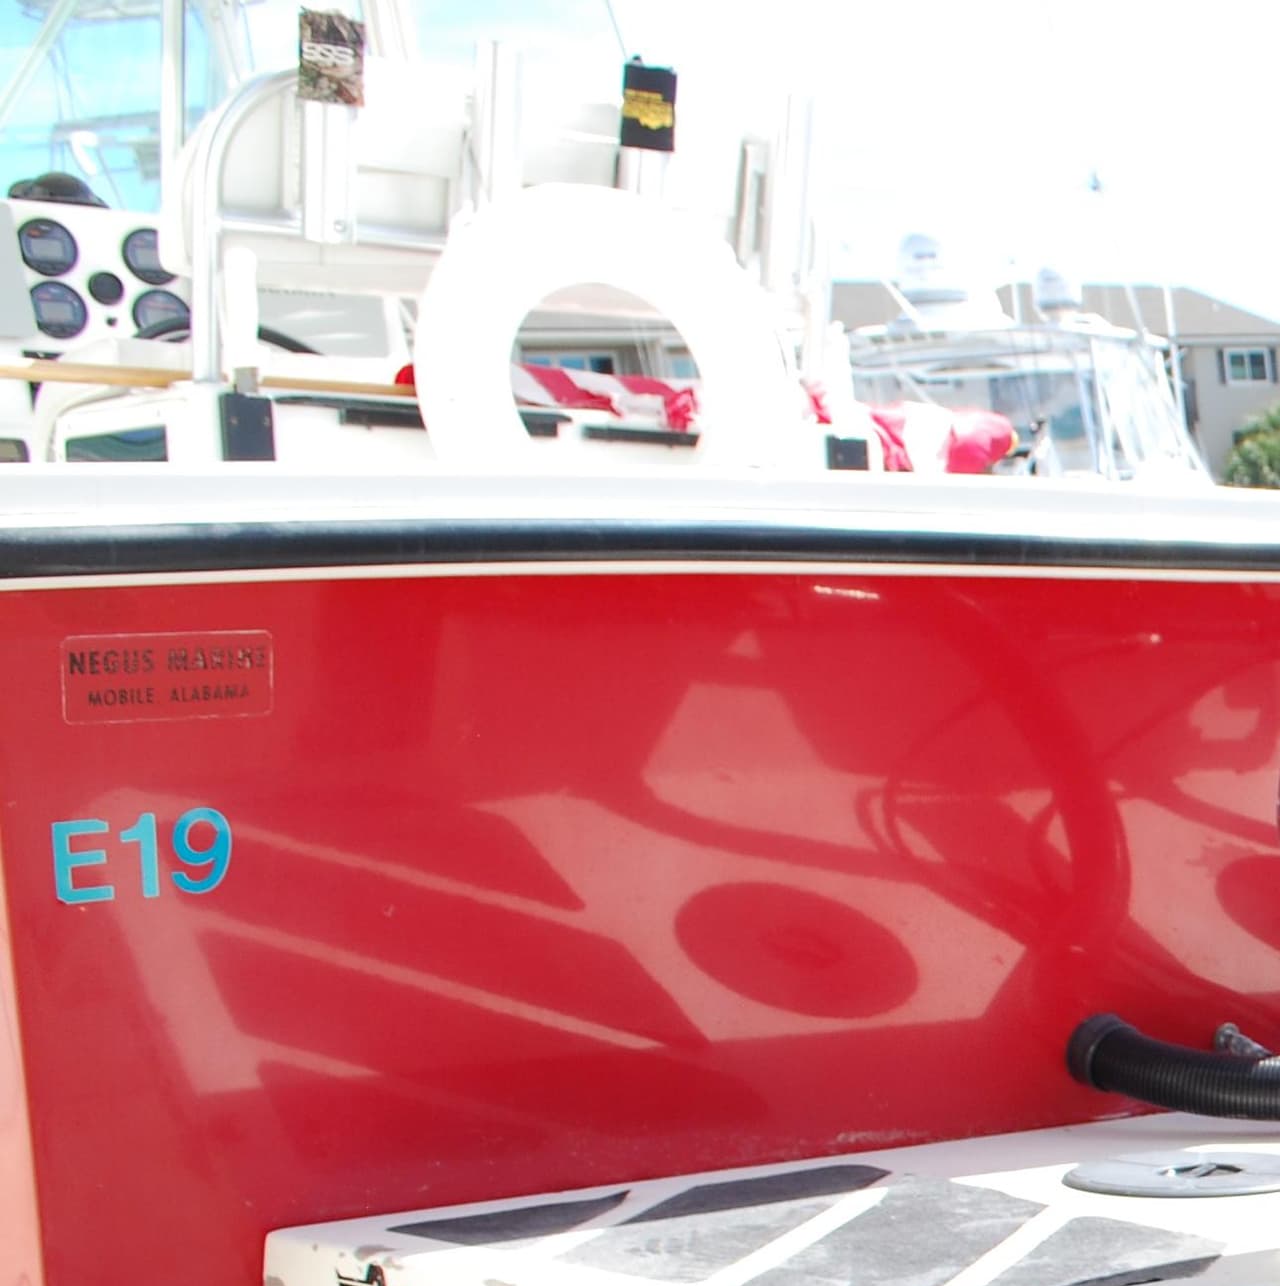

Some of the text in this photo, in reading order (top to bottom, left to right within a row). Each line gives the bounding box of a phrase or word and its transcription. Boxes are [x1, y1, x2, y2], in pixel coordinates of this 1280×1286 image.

[68, 645, 265, 675] NEGUS MARINE
[88, 684, 249, 707] MOBILE ALABAMA
[51, 807, 232, 904] E19
